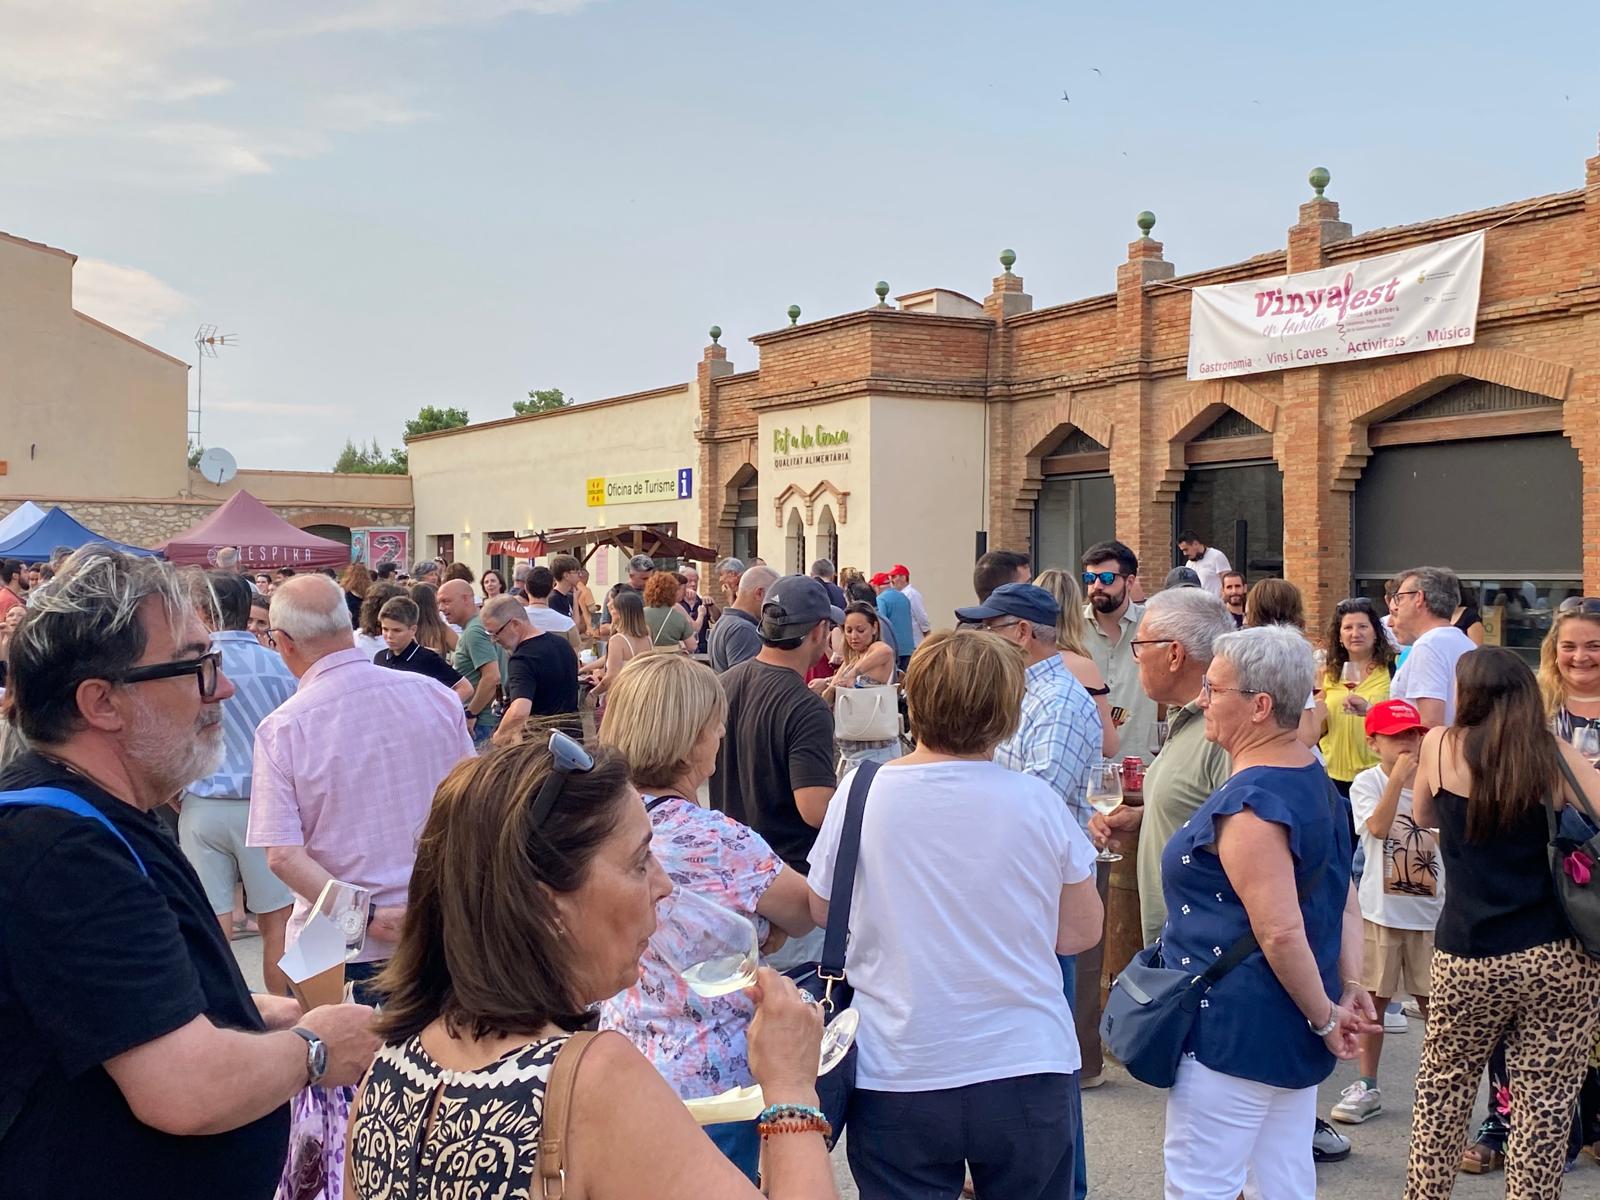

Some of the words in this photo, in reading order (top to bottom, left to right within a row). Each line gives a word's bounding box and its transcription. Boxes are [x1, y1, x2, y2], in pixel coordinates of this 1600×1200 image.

[1254, 272, 1400, 320] Vinyafest
[1427, 326, 1471, 343] Música
[1347, 336, 1406, 354] Activitats
[1266, 350, 1288, 365] Vins
[1290, 349, 1295, 361] i
[1296, 345, 1328, 361] Caves
[1199, 356, 1252, 375] Gastronomia
[774, 456, 803, 468] QUALITAT
[805, 451, 849, 465] ALIMENTÀRIA
[608, 482, 632, 497] Oficina
[633, 482, 643, 495] de
[645, 479, 675, 494] Turisme
